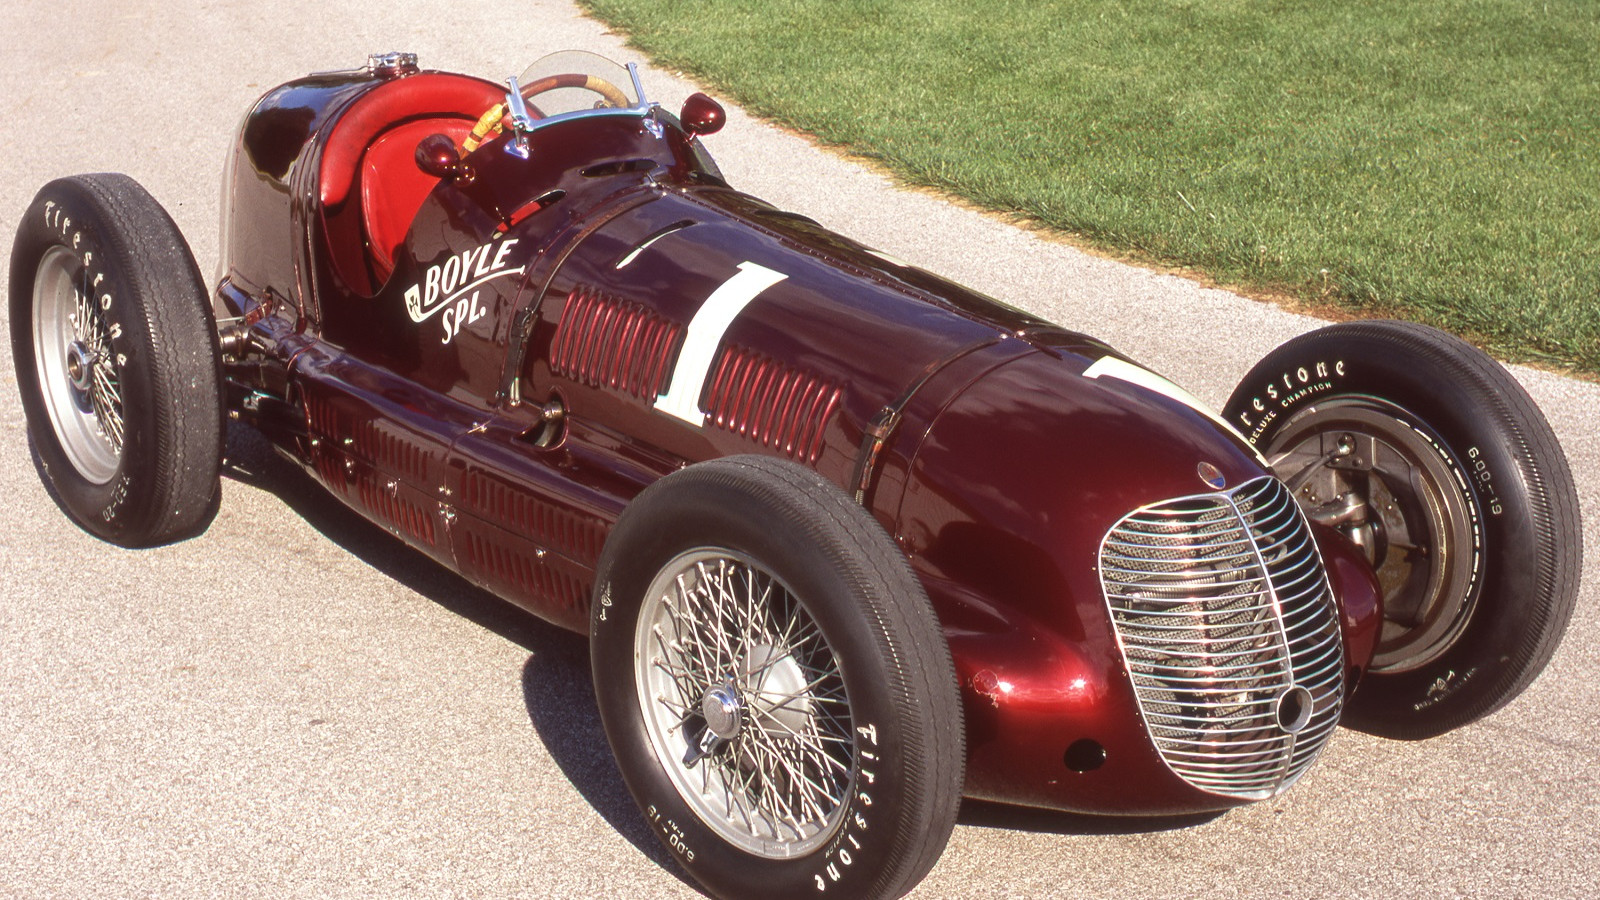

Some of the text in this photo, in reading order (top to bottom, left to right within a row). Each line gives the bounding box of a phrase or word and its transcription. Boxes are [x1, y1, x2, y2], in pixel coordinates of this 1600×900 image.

[45, 200, 127, 366] Firestone
[424, 238, 519, 307] BOYLE
[441, 290, 486, 345] SPL.
[653, 260, 789, 428] 1
[1240, 360, 1345, 427] restone
[1249, 381, 1332, 444] DELUXE CHAMPION
[814, 723, 880, 892] Firestone
